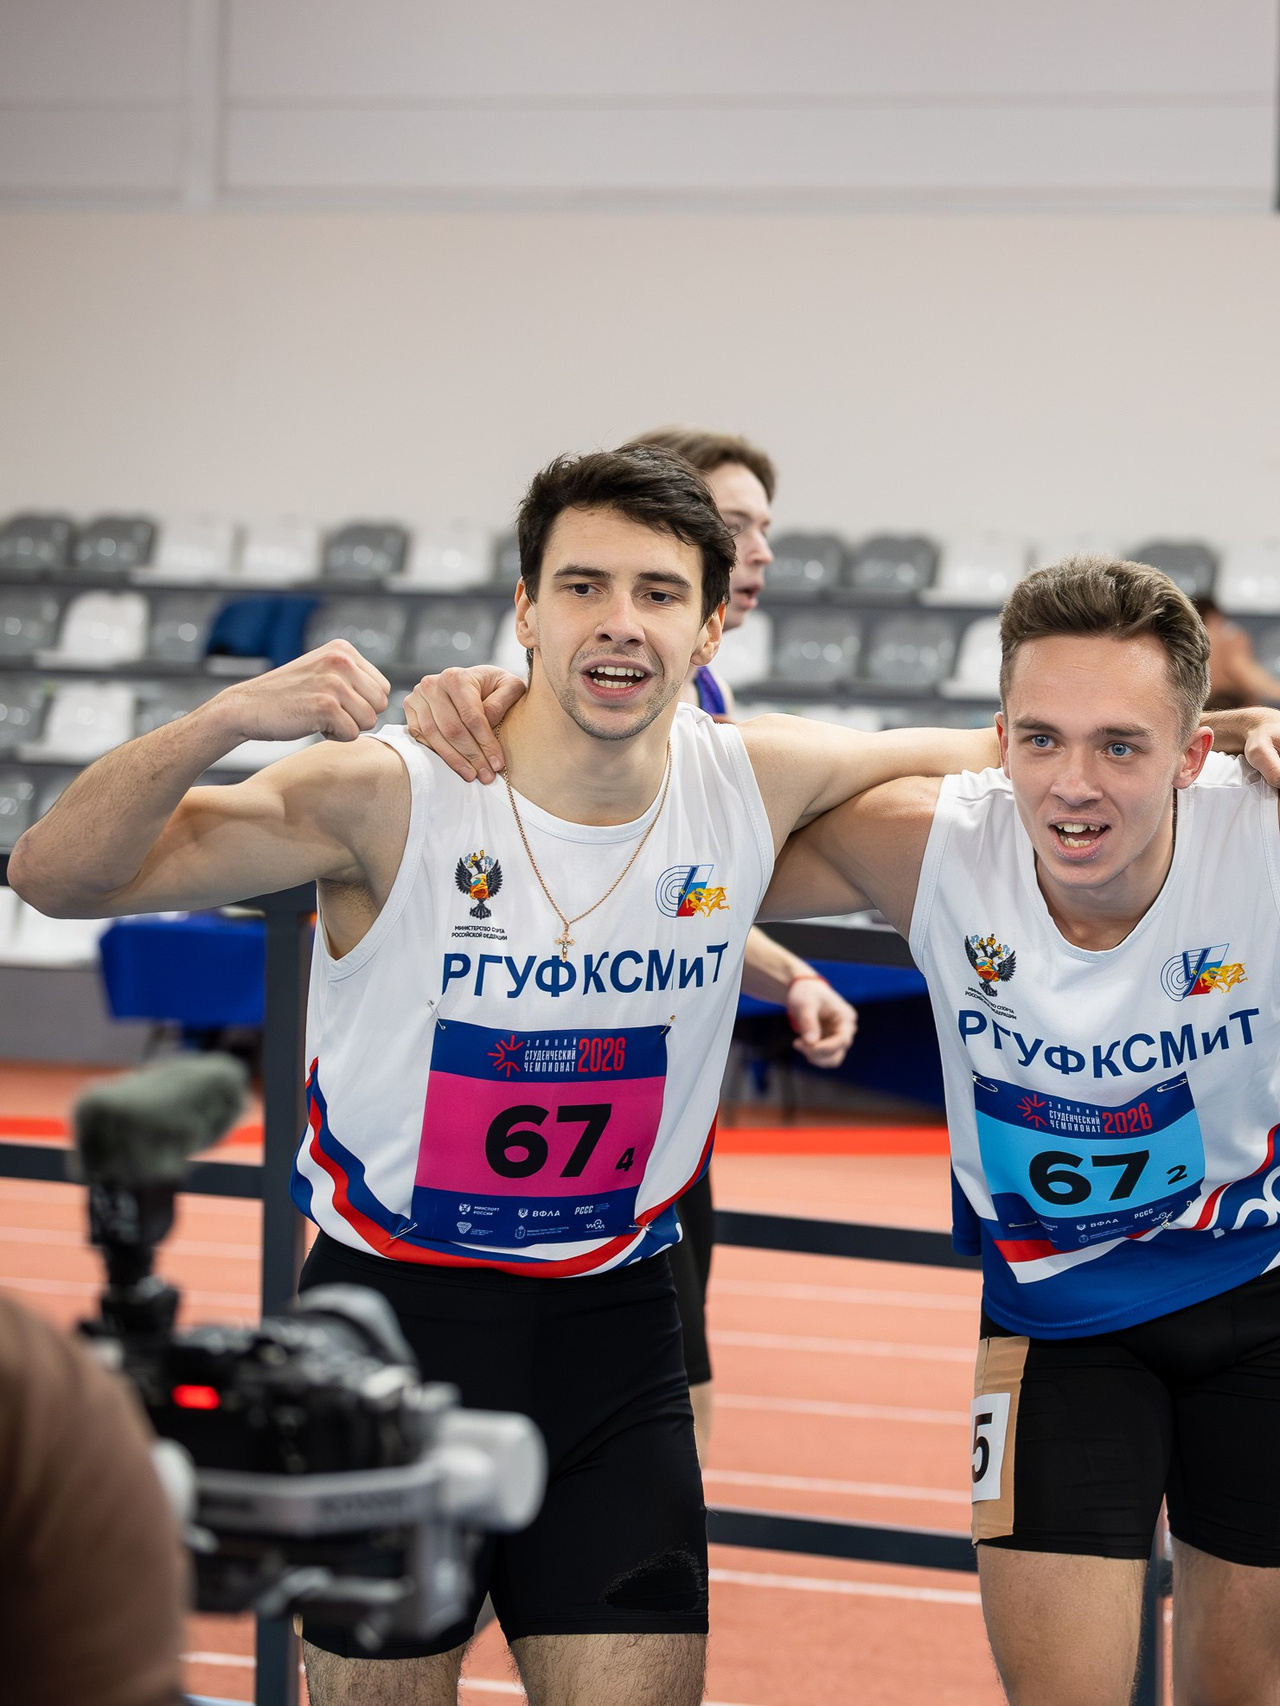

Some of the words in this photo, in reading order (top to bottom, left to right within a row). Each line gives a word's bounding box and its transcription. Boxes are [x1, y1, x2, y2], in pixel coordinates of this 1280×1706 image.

[442, 941, 729, 999] РГУФКСМиТ
[958, 1008, 1260, 1078] РГУФКСМиТ
[524, 1047, 577, 1061] СТУДЕНЧЕСКИЙ
[577, 1036, 626, 1073] 2026
[523, 1061, 576, 1073] ЧЕМПИОНАТ
[1049, 1110, 1100, 1125] СТУДЕНЧЕСКИЙ
[1102, 1102, 1153, 1134] 2026
[1049, 1119, 1101, 1133] ЧЕМПИОНАТ
[485, 1103, 612, 1179] 67
[615, 1147, 634, 1172] 4
[1028, 1149, 1150, 1205] 67
[1166, 1164, 1188, 1185] 2
[532, 1210, 561, 1218] ВФЛА
[574, 1205, 594, 1216] РССС
[1134, 1208, 1154, 1219] РССС
[1090, 1218, 1119, 1228] ВФЛА
[971, 1412, 993, 1484] 5
